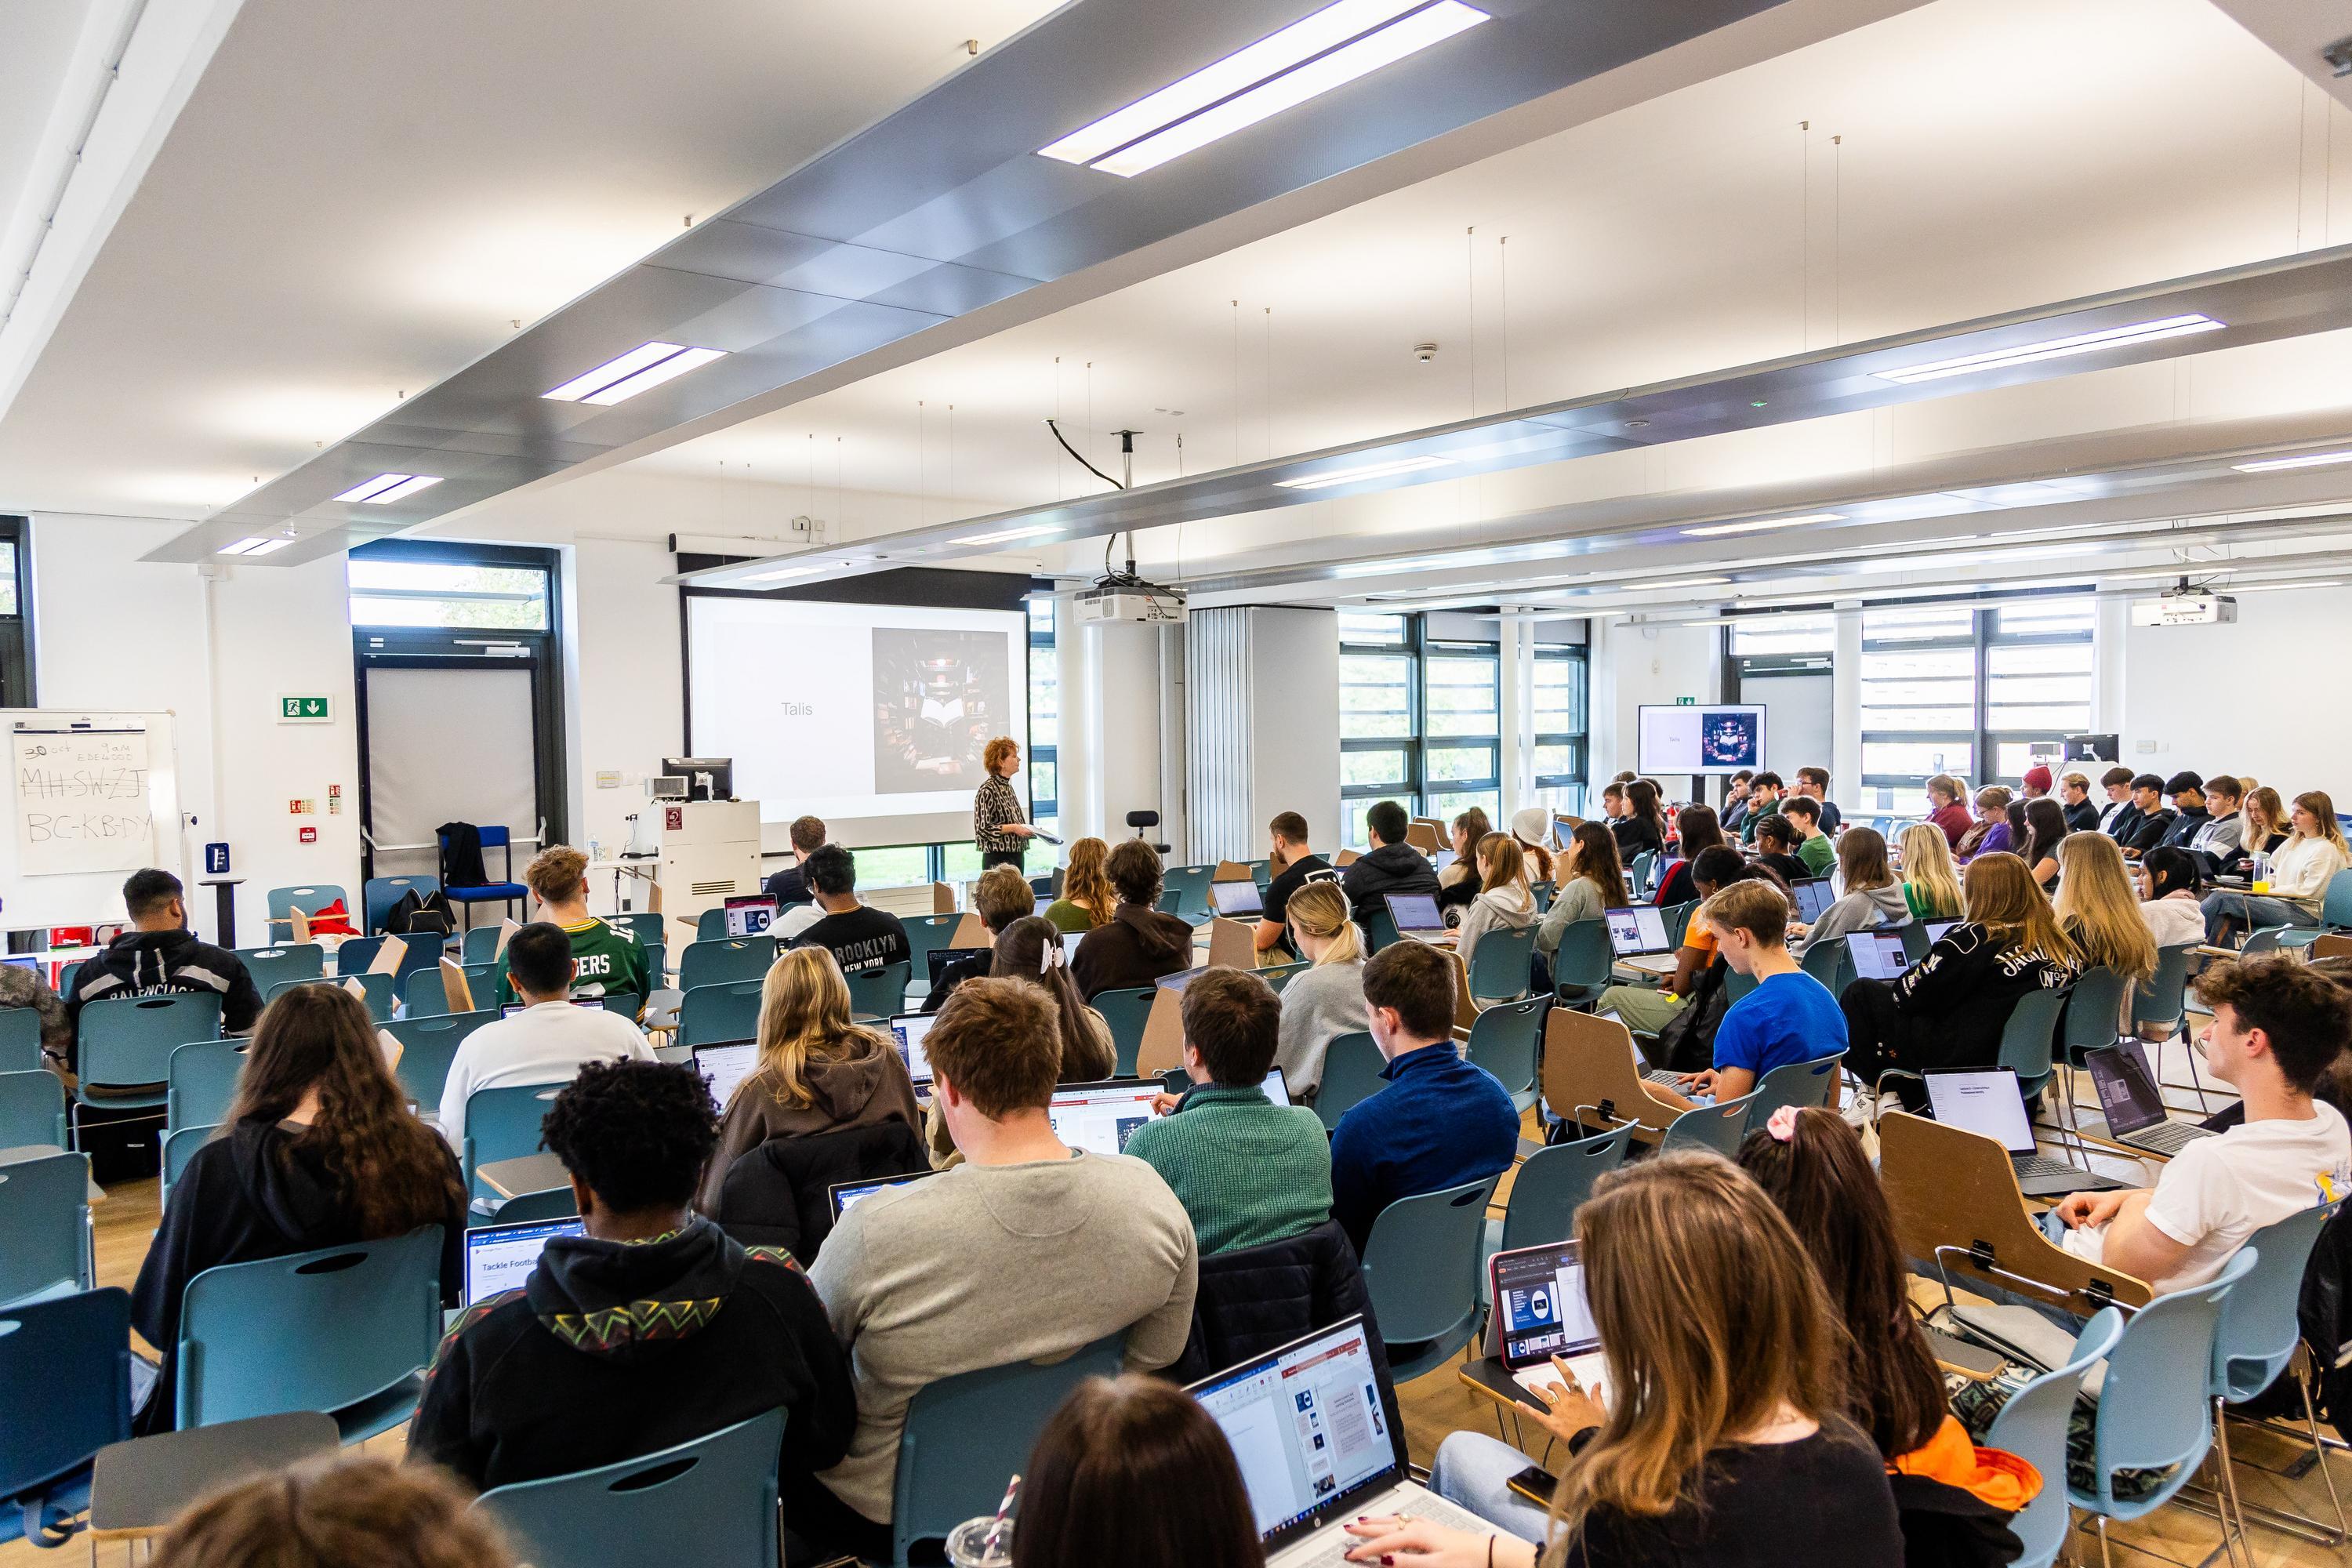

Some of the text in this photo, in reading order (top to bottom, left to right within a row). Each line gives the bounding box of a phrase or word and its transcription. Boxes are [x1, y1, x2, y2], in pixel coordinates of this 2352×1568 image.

[781, 702, 813, 716] Talis
[24, 746, 47, 760] 30
[834, 933, 897, 965] ROOKLYN
[844, 956, 884, 973] NEW YORK
[110, 983, 195, 1000] BALENCIA
[510, 1258, 539, 1269] Footba
